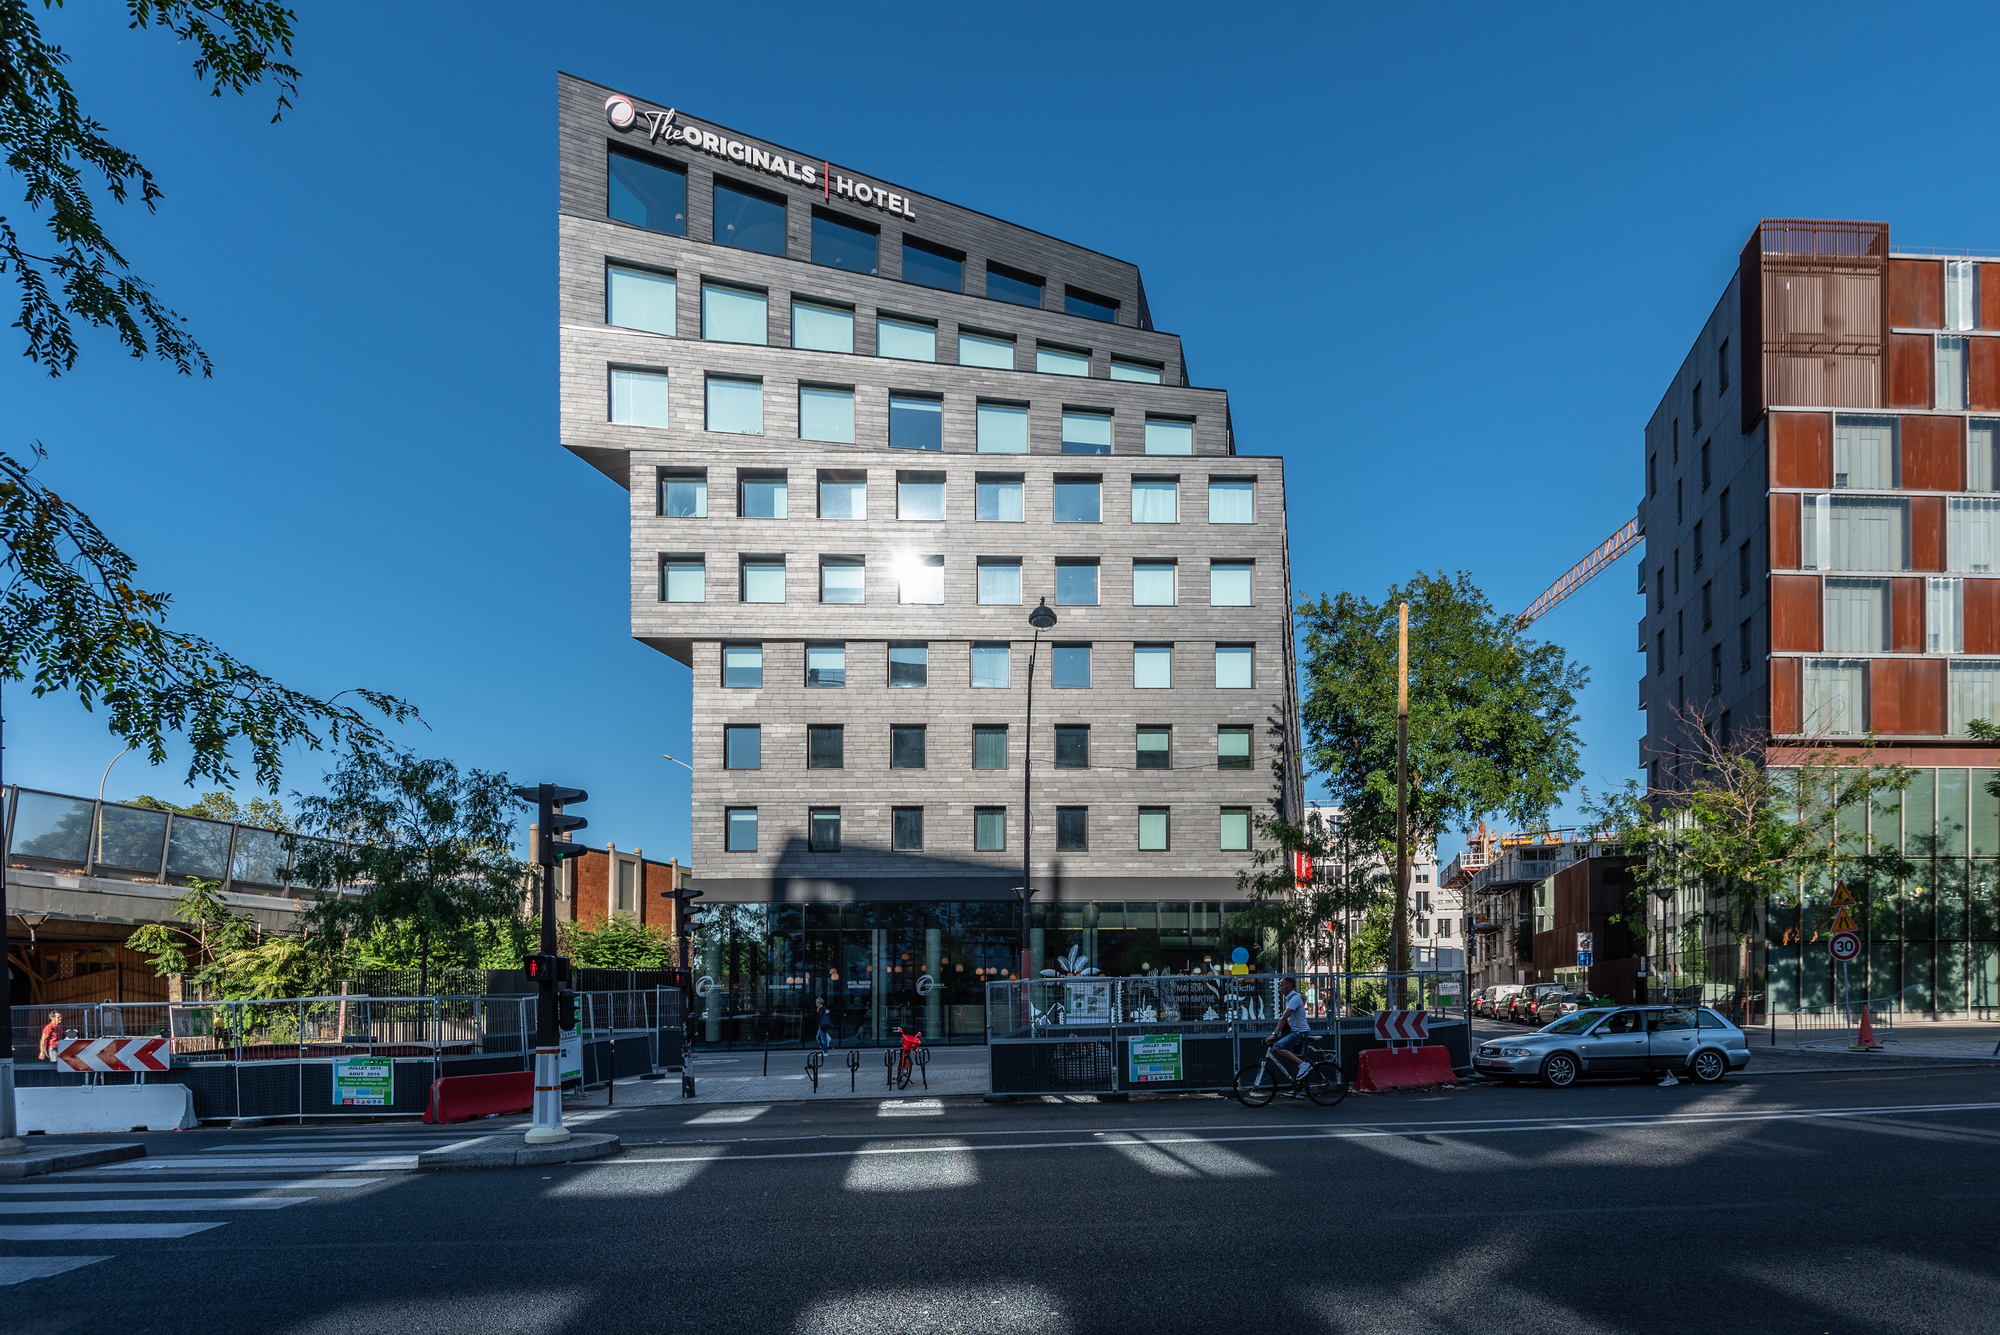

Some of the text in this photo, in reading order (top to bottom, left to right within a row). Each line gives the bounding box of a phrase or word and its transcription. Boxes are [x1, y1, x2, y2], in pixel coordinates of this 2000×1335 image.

[684, 126, 817, 185] ORIGINALS
[837, 175, 915, 218] HOTEL
[1836, 940, 1854, 953] 30
